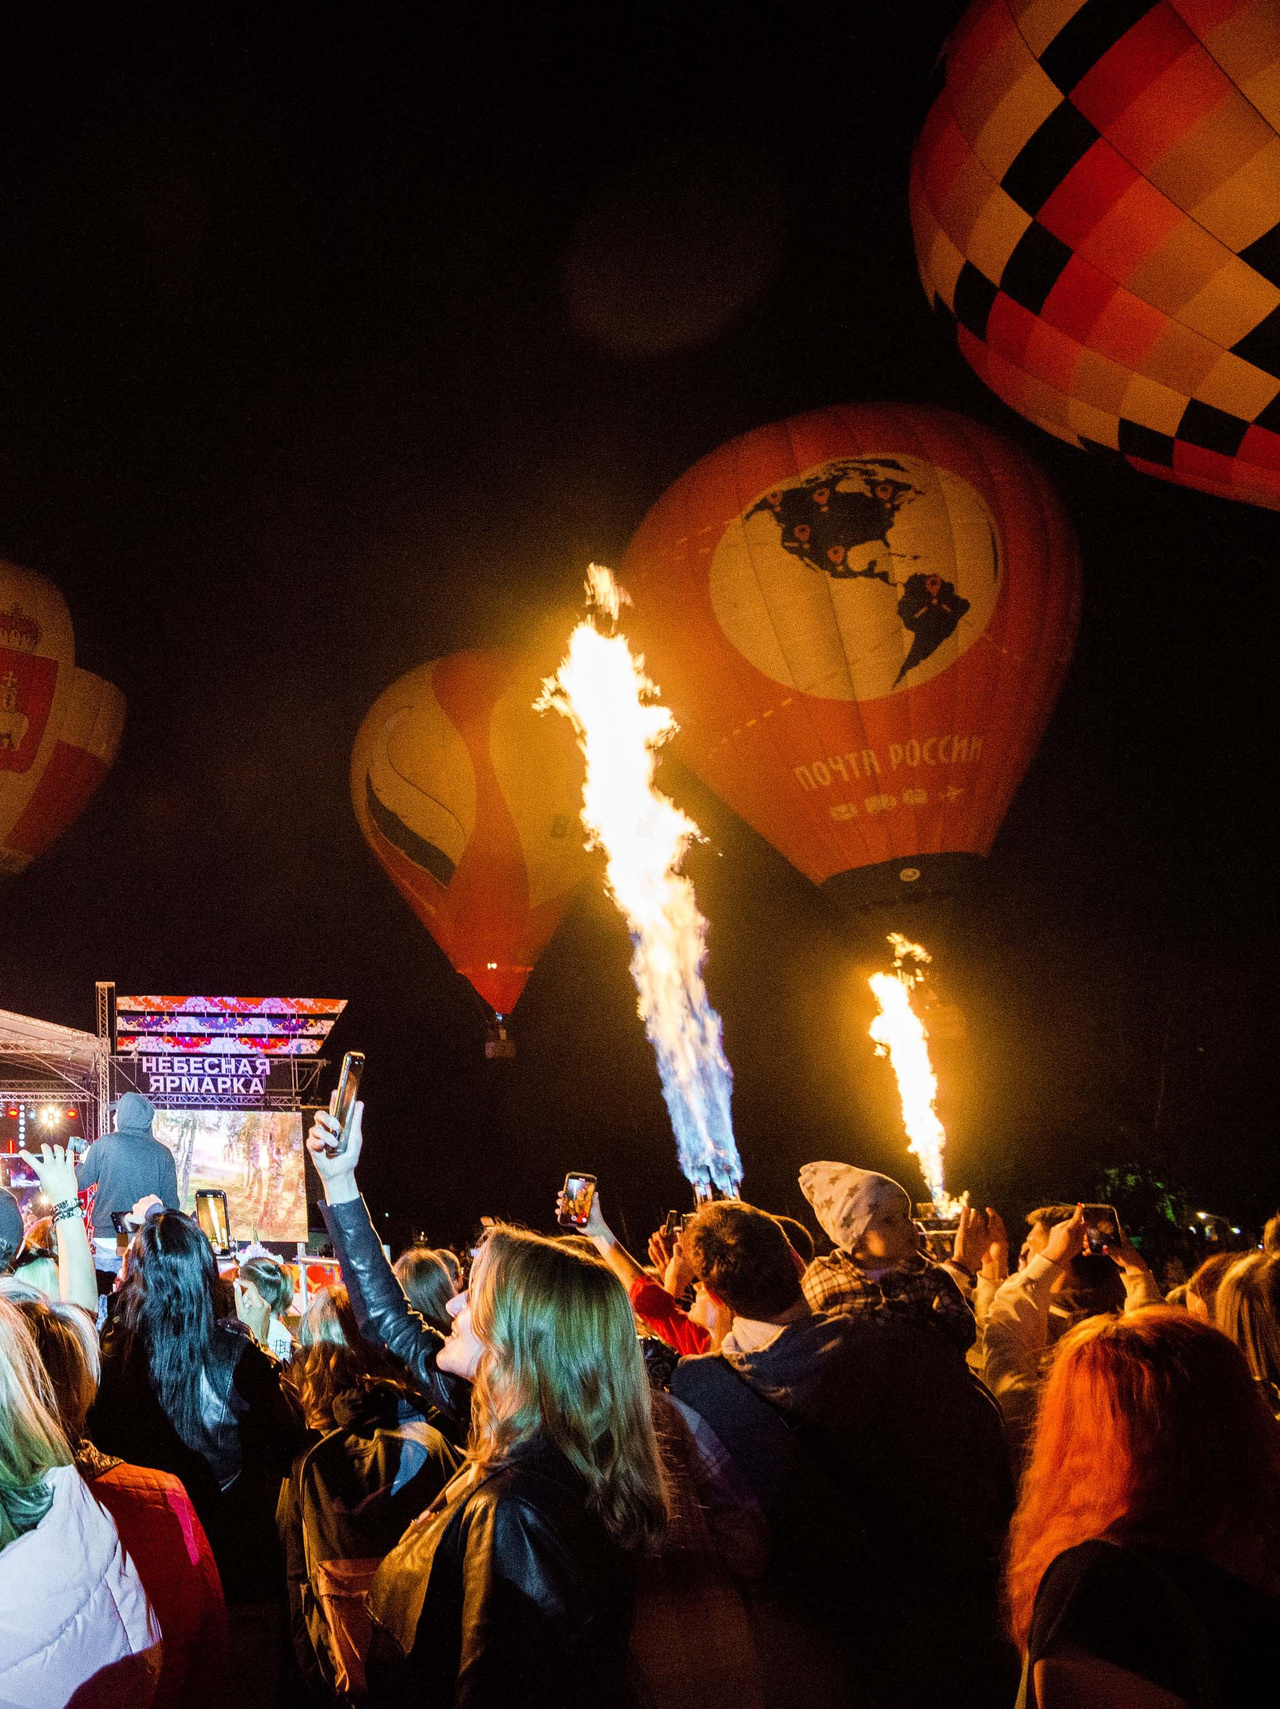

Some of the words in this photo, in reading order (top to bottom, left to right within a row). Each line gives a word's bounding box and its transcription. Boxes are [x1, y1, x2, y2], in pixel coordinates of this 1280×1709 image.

[795, 749, 881, 792] ПОЧТА
[889, 735, 983, 771] РОССИИ
[142, 1056, 270, 1075] НЕБЕСНАЯ
[149, 1075, 265, 1094] ЯРМАРКА
